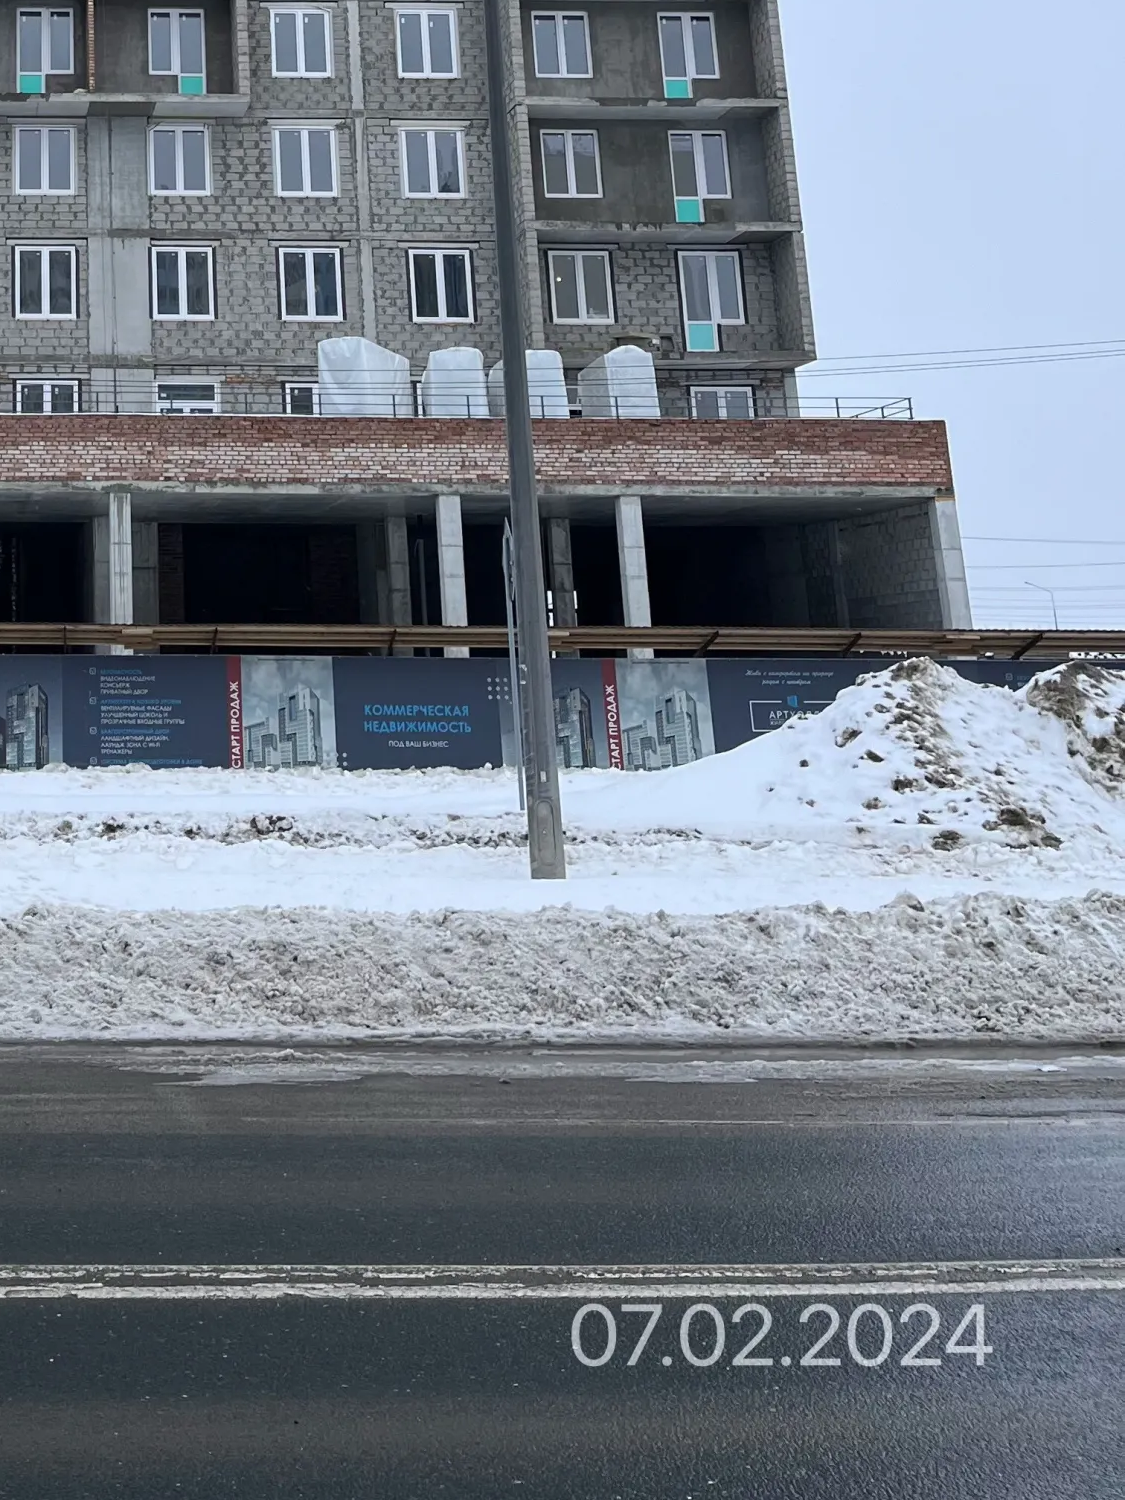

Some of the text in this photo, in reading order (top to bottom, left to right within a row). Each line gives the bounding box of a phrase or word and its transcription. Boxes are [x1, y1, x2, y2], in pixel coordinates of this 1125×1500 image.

[230, 682, 241, 768] СТАРТ ПРОДАЖ
[364, 705, 468, 716] КОММЕРЧЕСКАЯ
[605, 685, 617, 735] ПРОДАЖ
[364, 721, 471, 733] НЕДВИЖИМОСТЬ
